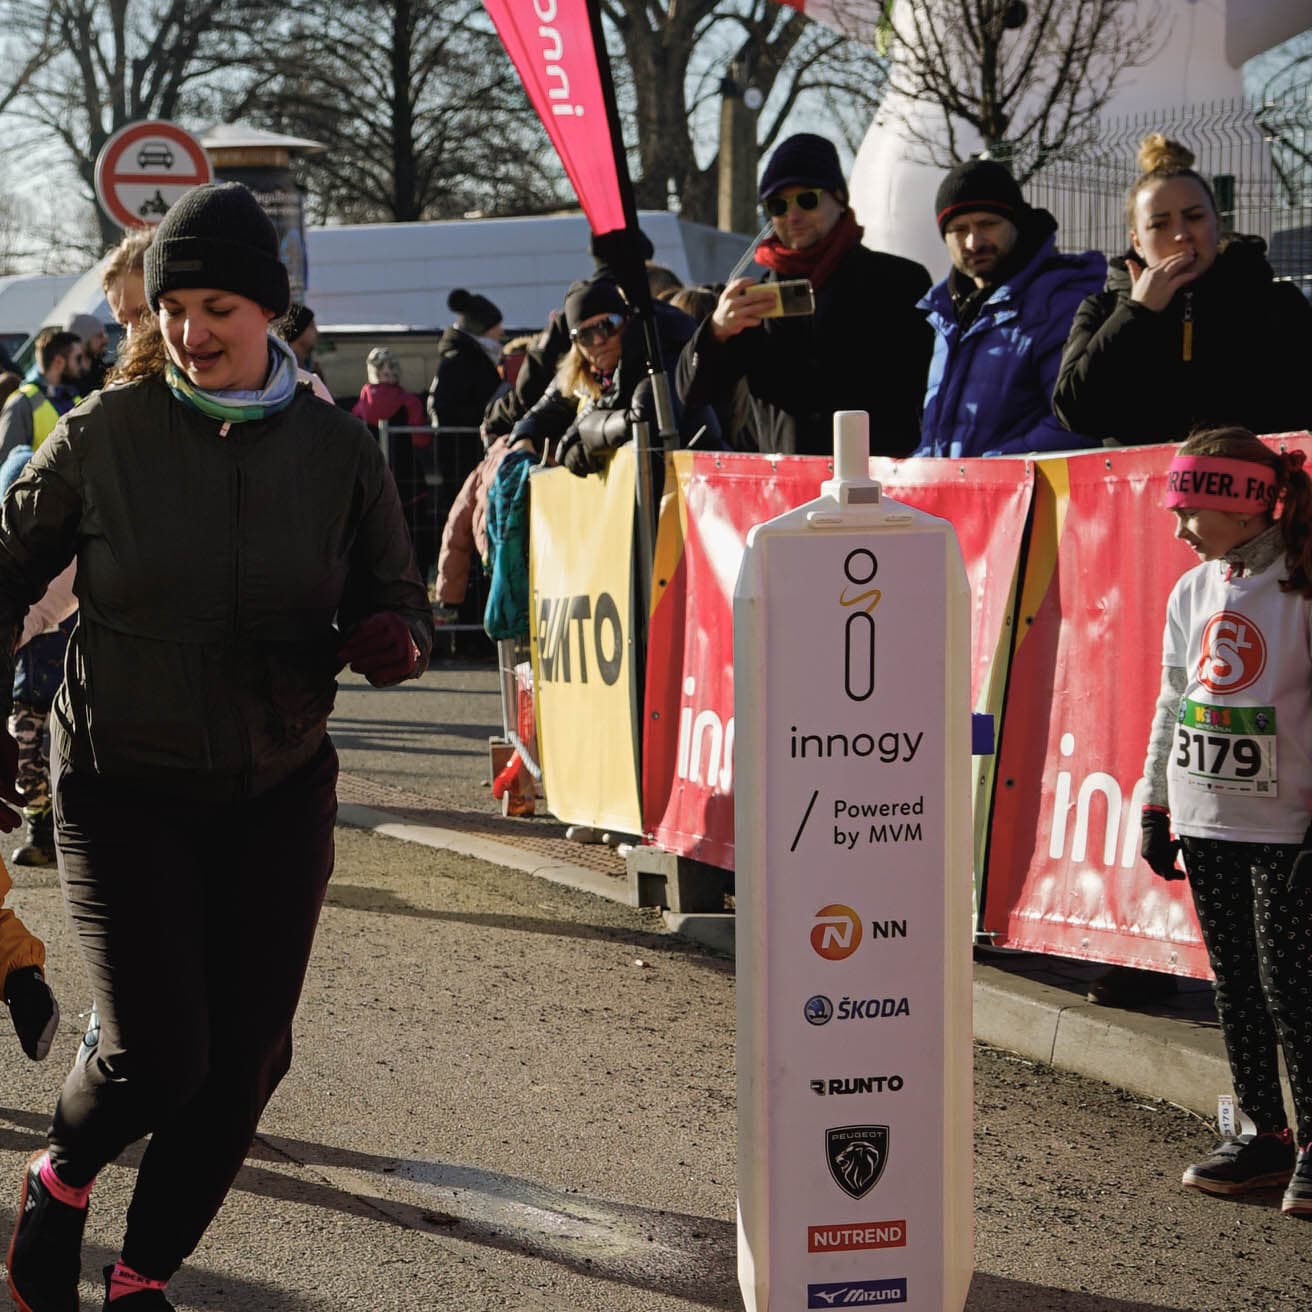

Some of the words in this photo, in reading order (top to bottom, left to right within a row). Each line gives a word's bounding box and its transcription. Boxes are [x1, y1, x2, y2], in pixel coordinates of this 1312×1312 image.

[1169, 471, 1238, 499] REVER.
[792, 726, 924, 764] innogy
[1176, 729, 1262, 778] 3179
[834, 795, 924, 819] Powered
[834, 825, 860, 850] by
[869, 823, 922, 843] MVM
[871, 919, 907, 939] NN
[836, 996, 910, 1020] ŠKODA
[829, 1075, 904, 1096] RUNTO
[831, 1130, 884, 1141] PEUGEOT
[814, 1226, 902, 1246] NUTREND
